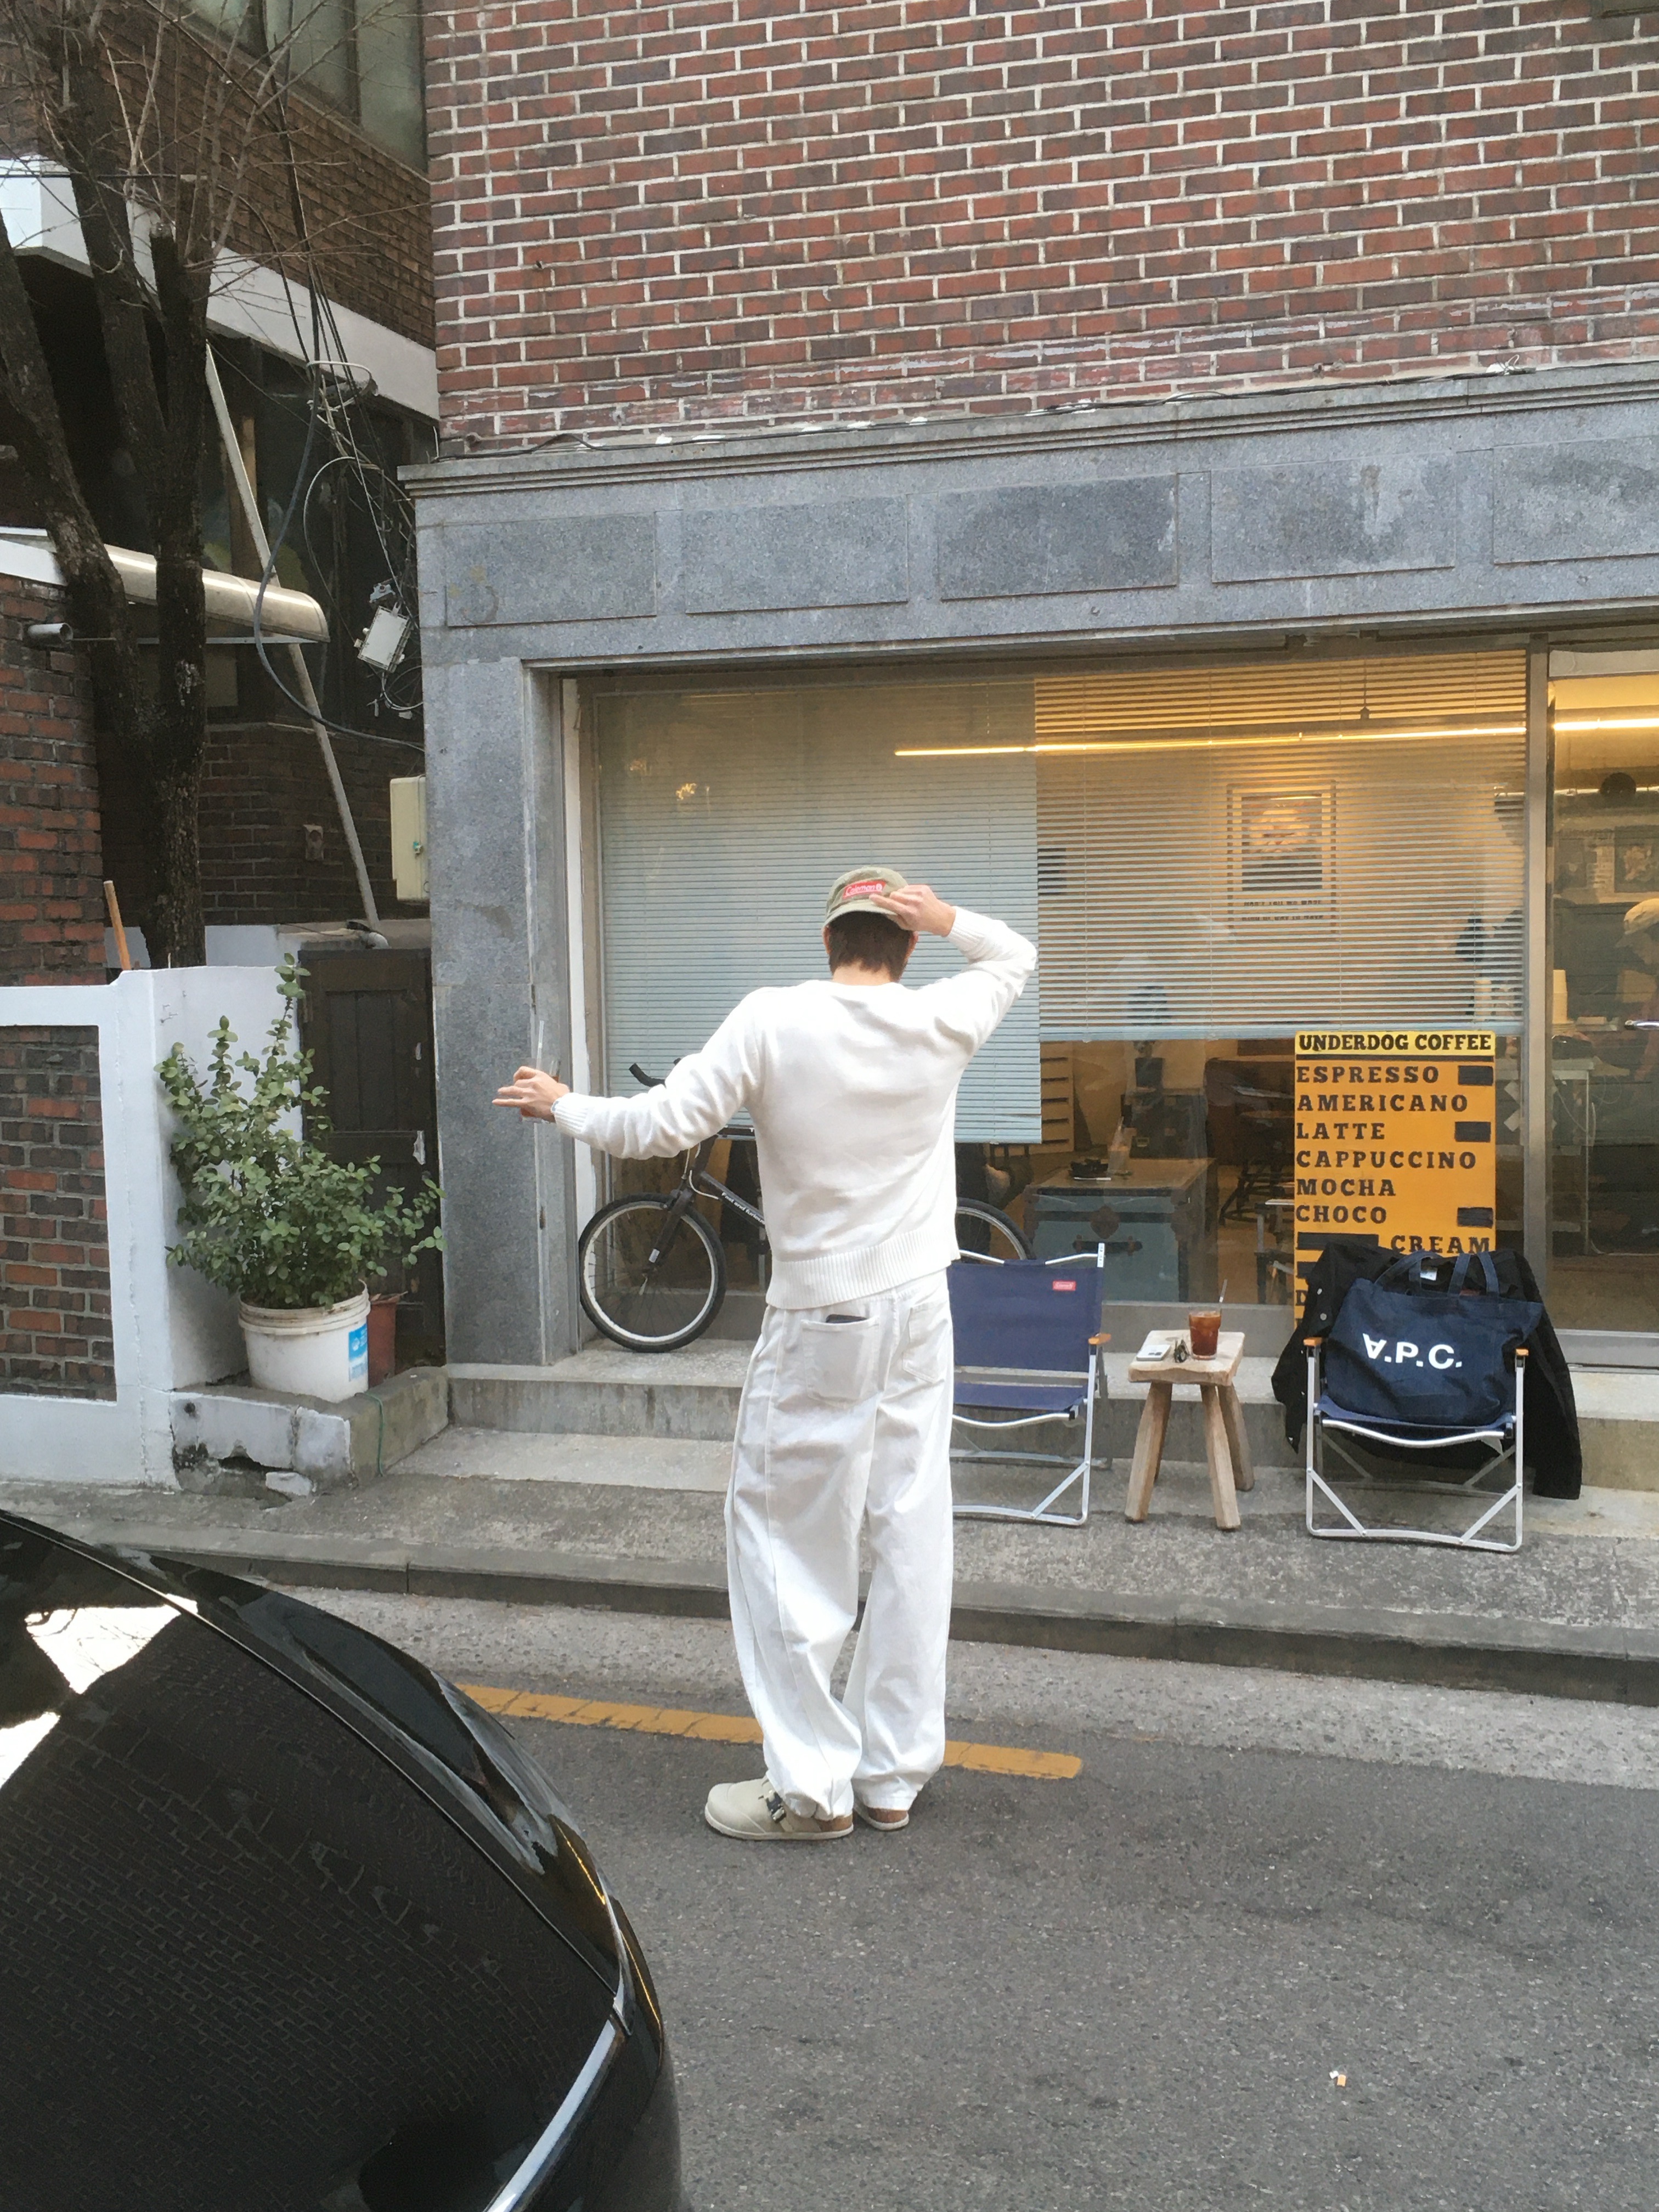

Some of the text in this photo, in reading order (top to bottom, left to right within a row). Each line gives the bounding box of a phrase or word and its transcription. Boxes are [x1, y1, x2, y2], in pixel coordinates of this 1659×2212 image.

[845, 884, 876, 896] Coleman
[1299, 1034, 1492, 1051] UNDERDOG COFFEE
[1296, 1066, 1439, 1083] ESPRESSO
[1297, 1094, 1468, 1112] AMERICANO
[1296, 1122, 1385, 1140] LATTE
[1296, 1150, 1476, 1169] CAPPUCCINO
[1296, 1179, 1396, 1197] MOCHA
[746, 1209, 765, 1225] furiou
[1296, 1205, 1387, 1224] CHOCO
[1390, 1235, 1490, 1254] CREAM
